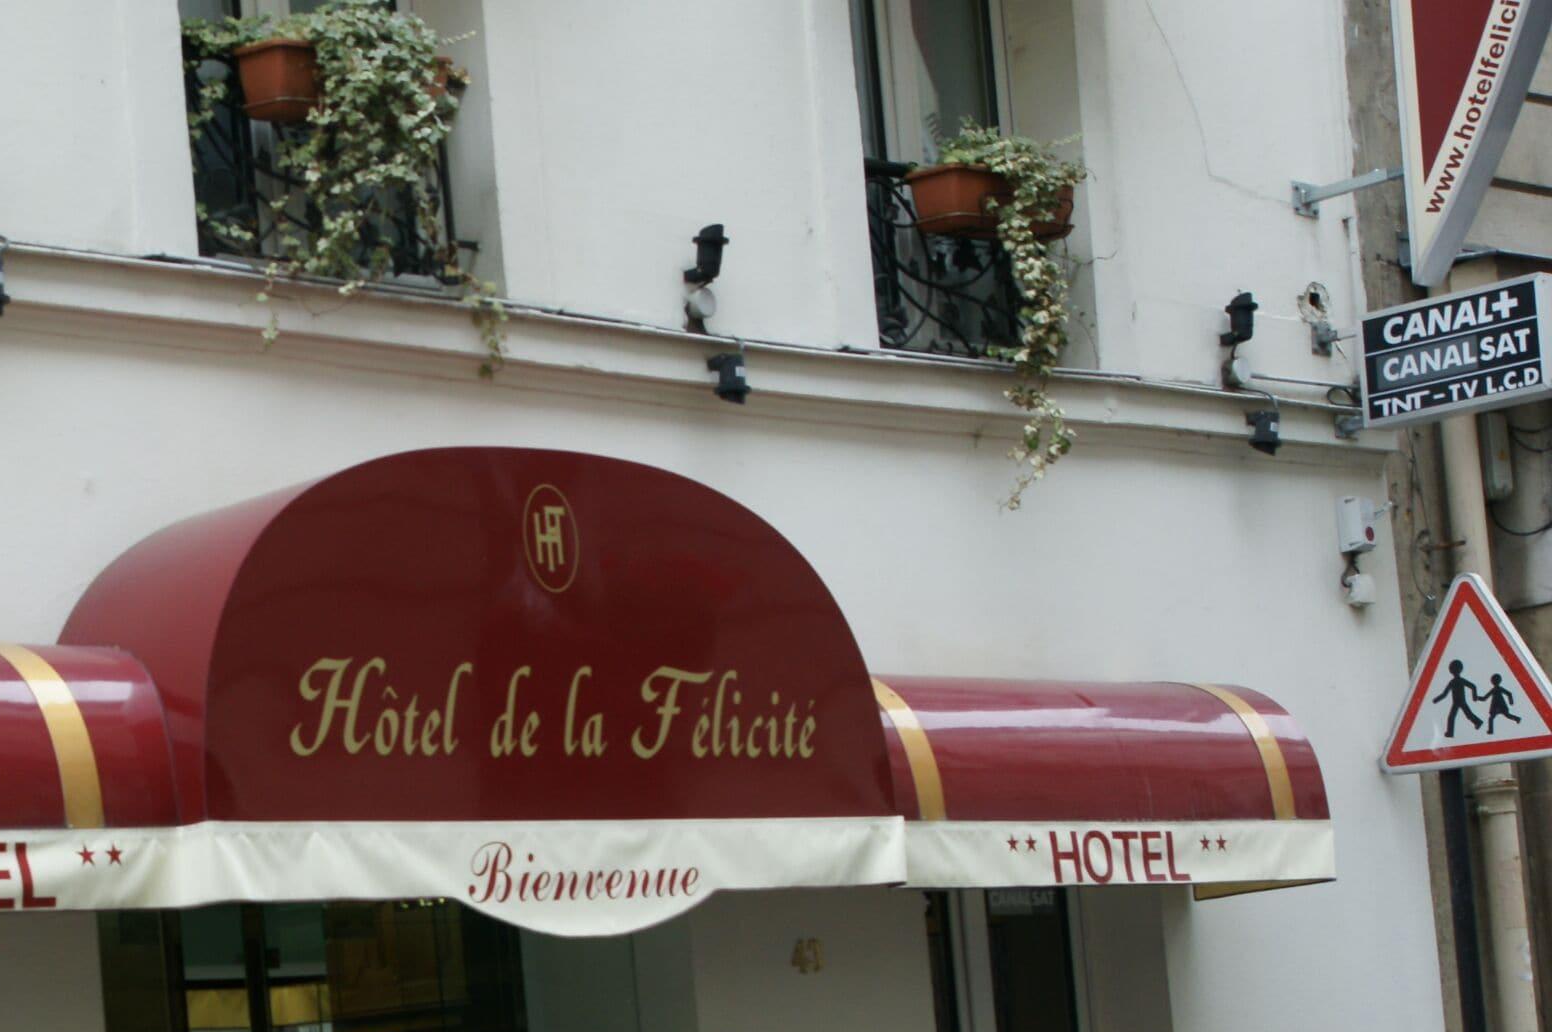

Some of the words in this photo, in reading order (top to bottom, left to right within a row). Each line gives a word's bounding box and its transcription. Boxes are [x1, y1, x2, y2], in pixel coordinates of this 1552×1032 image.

[1382, 290, 1518, 345] CANAL+
[1382, 341, 1477, 382] CANAL
[1480, 328, 1530, 362] SAT
[1373, 390, 1430, 417] TNT
[1448, 379, 1479, 402] TV
[1485, 367, 1540, 395] L.C.D
[289, 657, 472, 756] Hôtel
[490, 666, 540, 758] de
[563, 666, 608, 758] la
[631, 665, 816, 759] Félicité
[468, 841, 700, 904] Bienvenue
[1048, 830, 1192, 884] HOTEL
